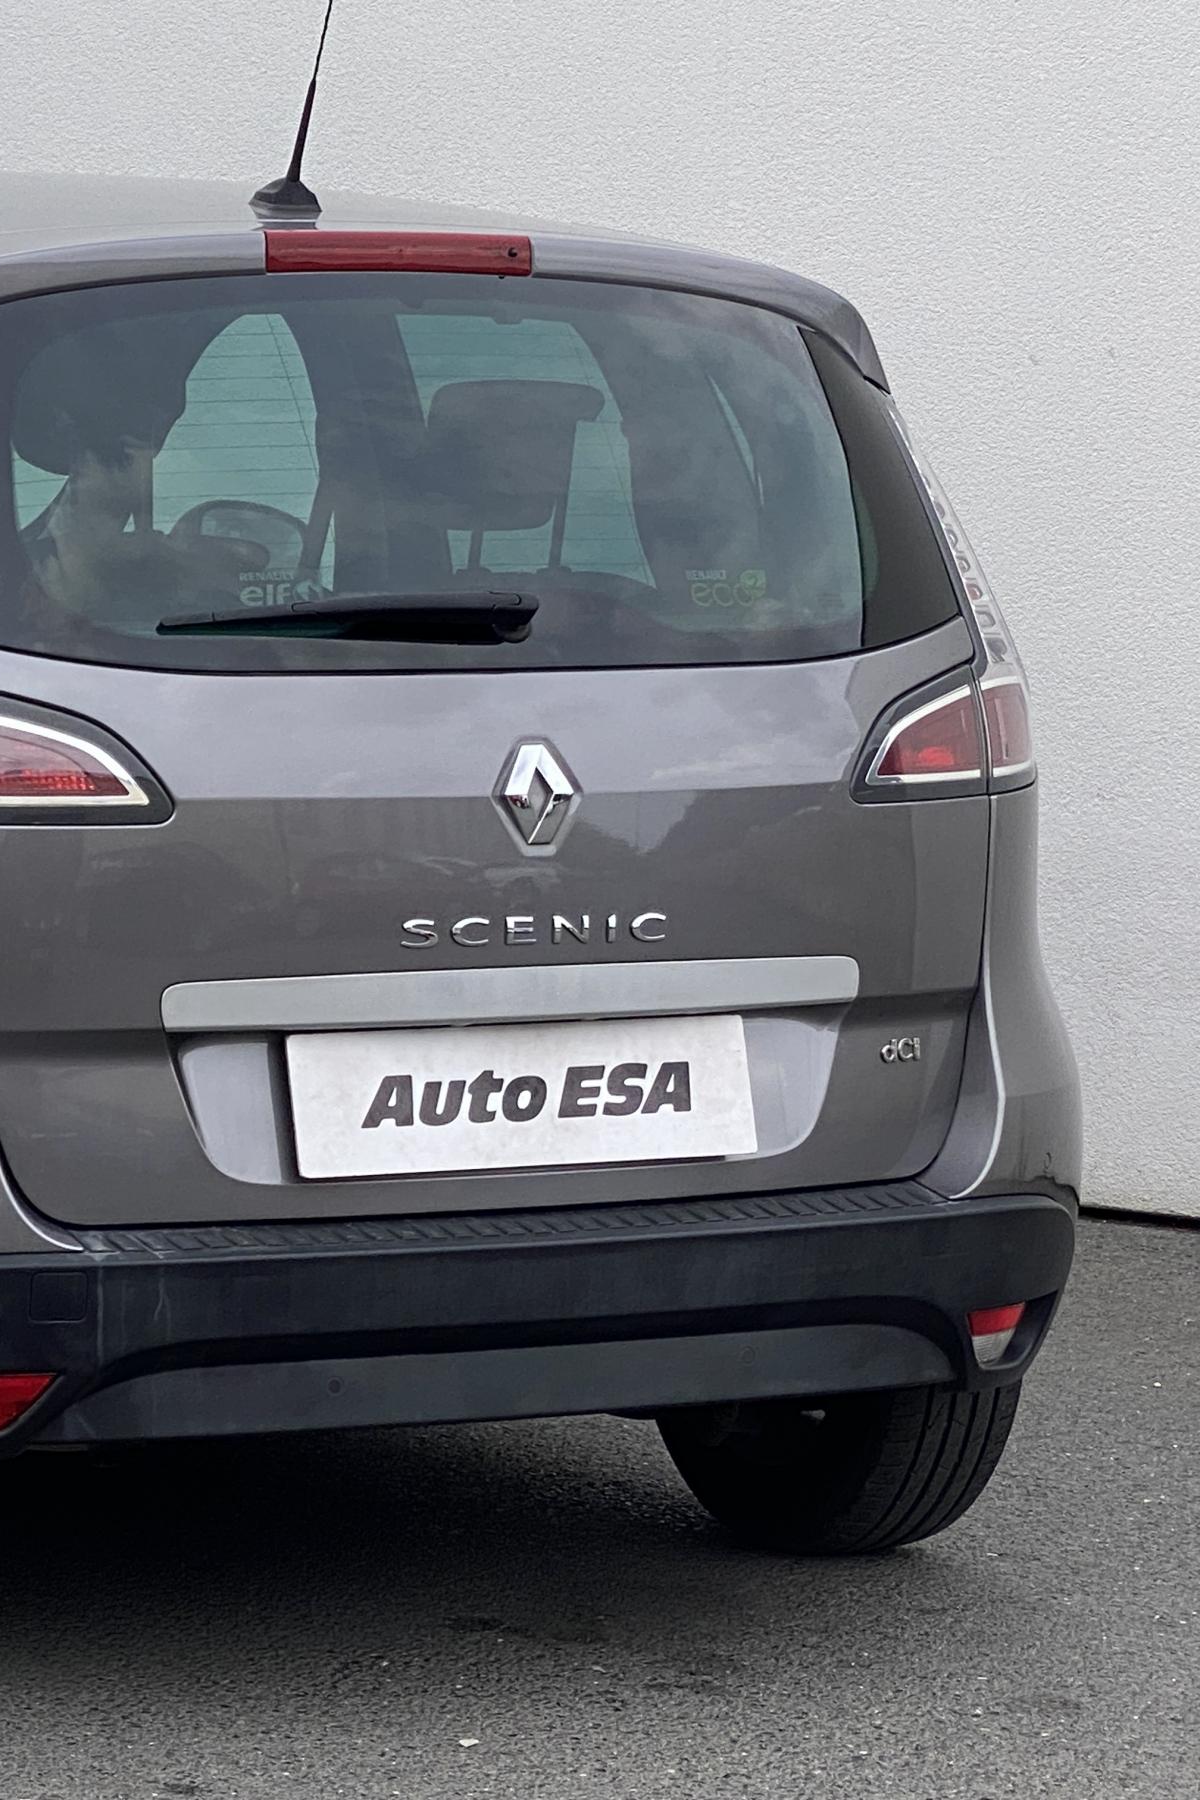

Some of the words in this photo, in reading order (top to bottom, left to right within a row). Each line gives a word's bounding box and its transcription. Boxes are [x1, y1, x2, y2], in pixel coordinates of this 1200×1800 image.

[240, 583, 292, 607] elf
[400, 911, 668, 949] SCENIC
[360, 1069, 548, 1129] Auto
[557, 1060, 693, 1119] ESA
